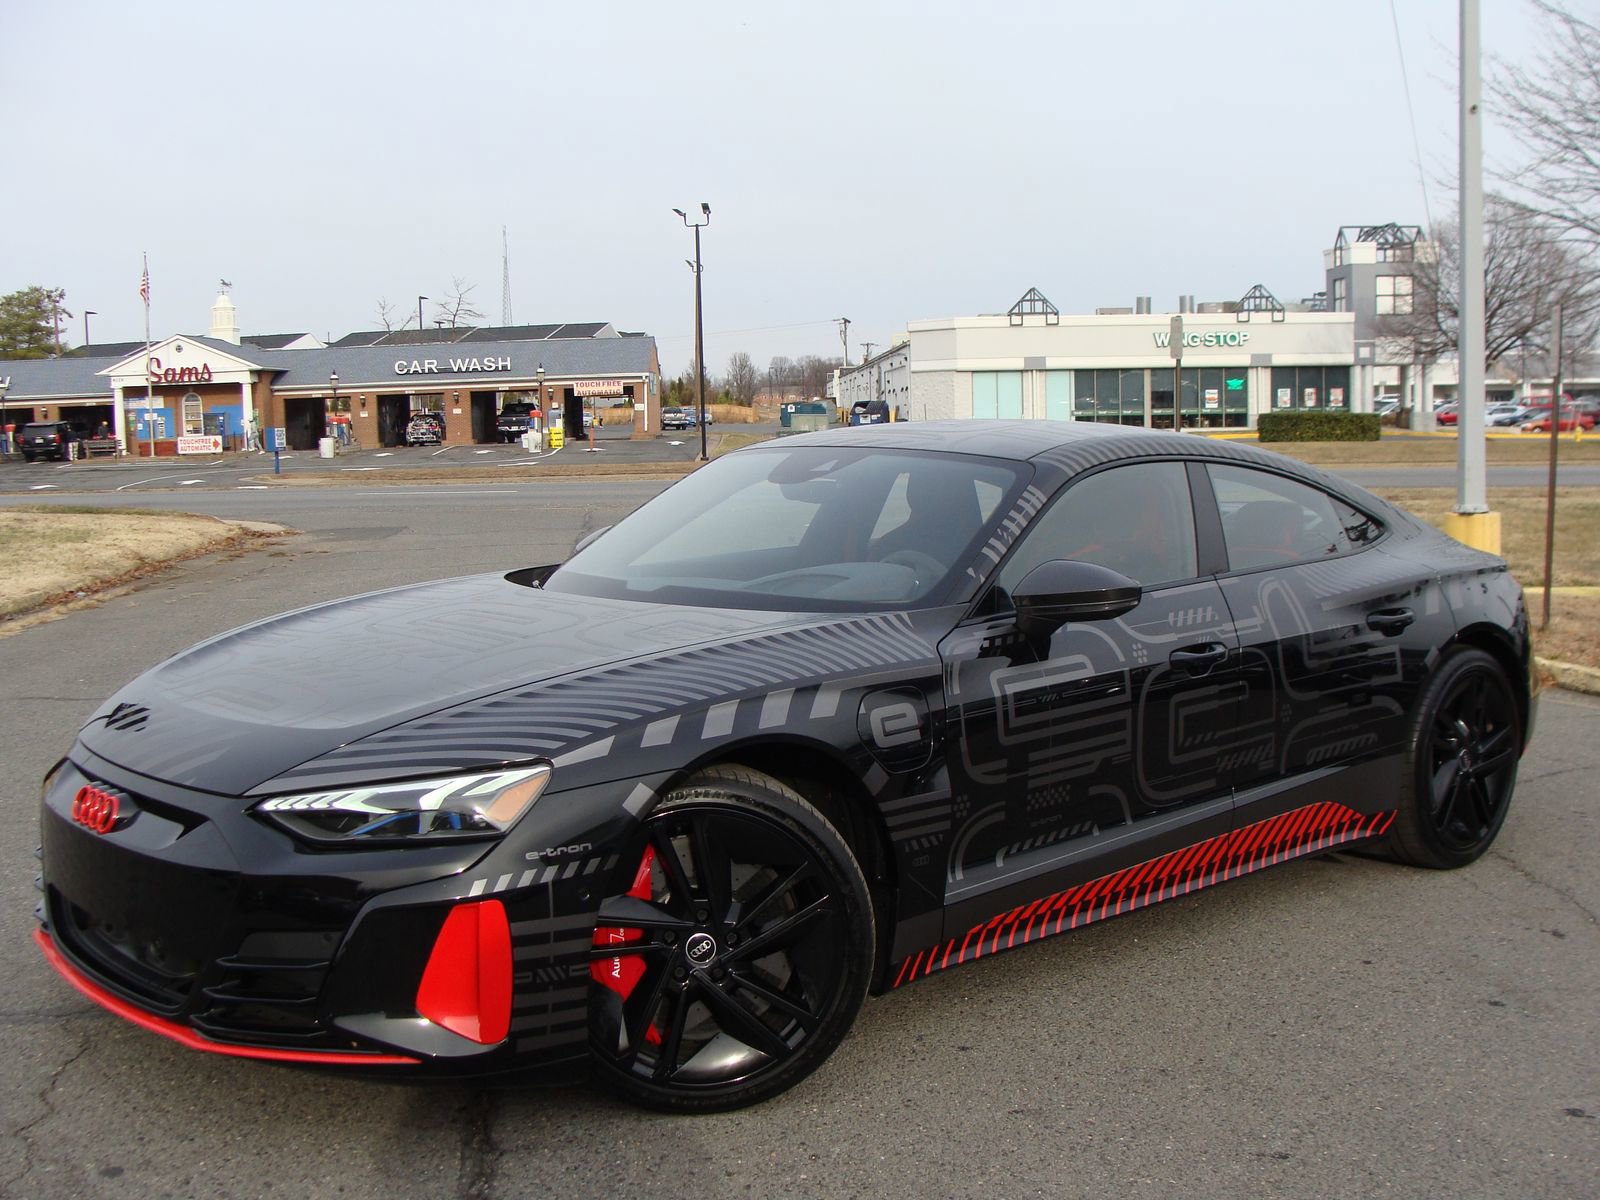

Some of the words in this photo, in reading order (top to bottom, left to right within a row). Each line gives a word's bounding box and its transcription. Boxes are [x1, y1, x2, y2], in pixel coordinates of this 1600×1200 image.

[145, 357, 213, 383] Sams
[394, 359, 439, 375] CAR
[449, 357, 512, 373] WASH
[525, 843, 592, 860] e-tron
